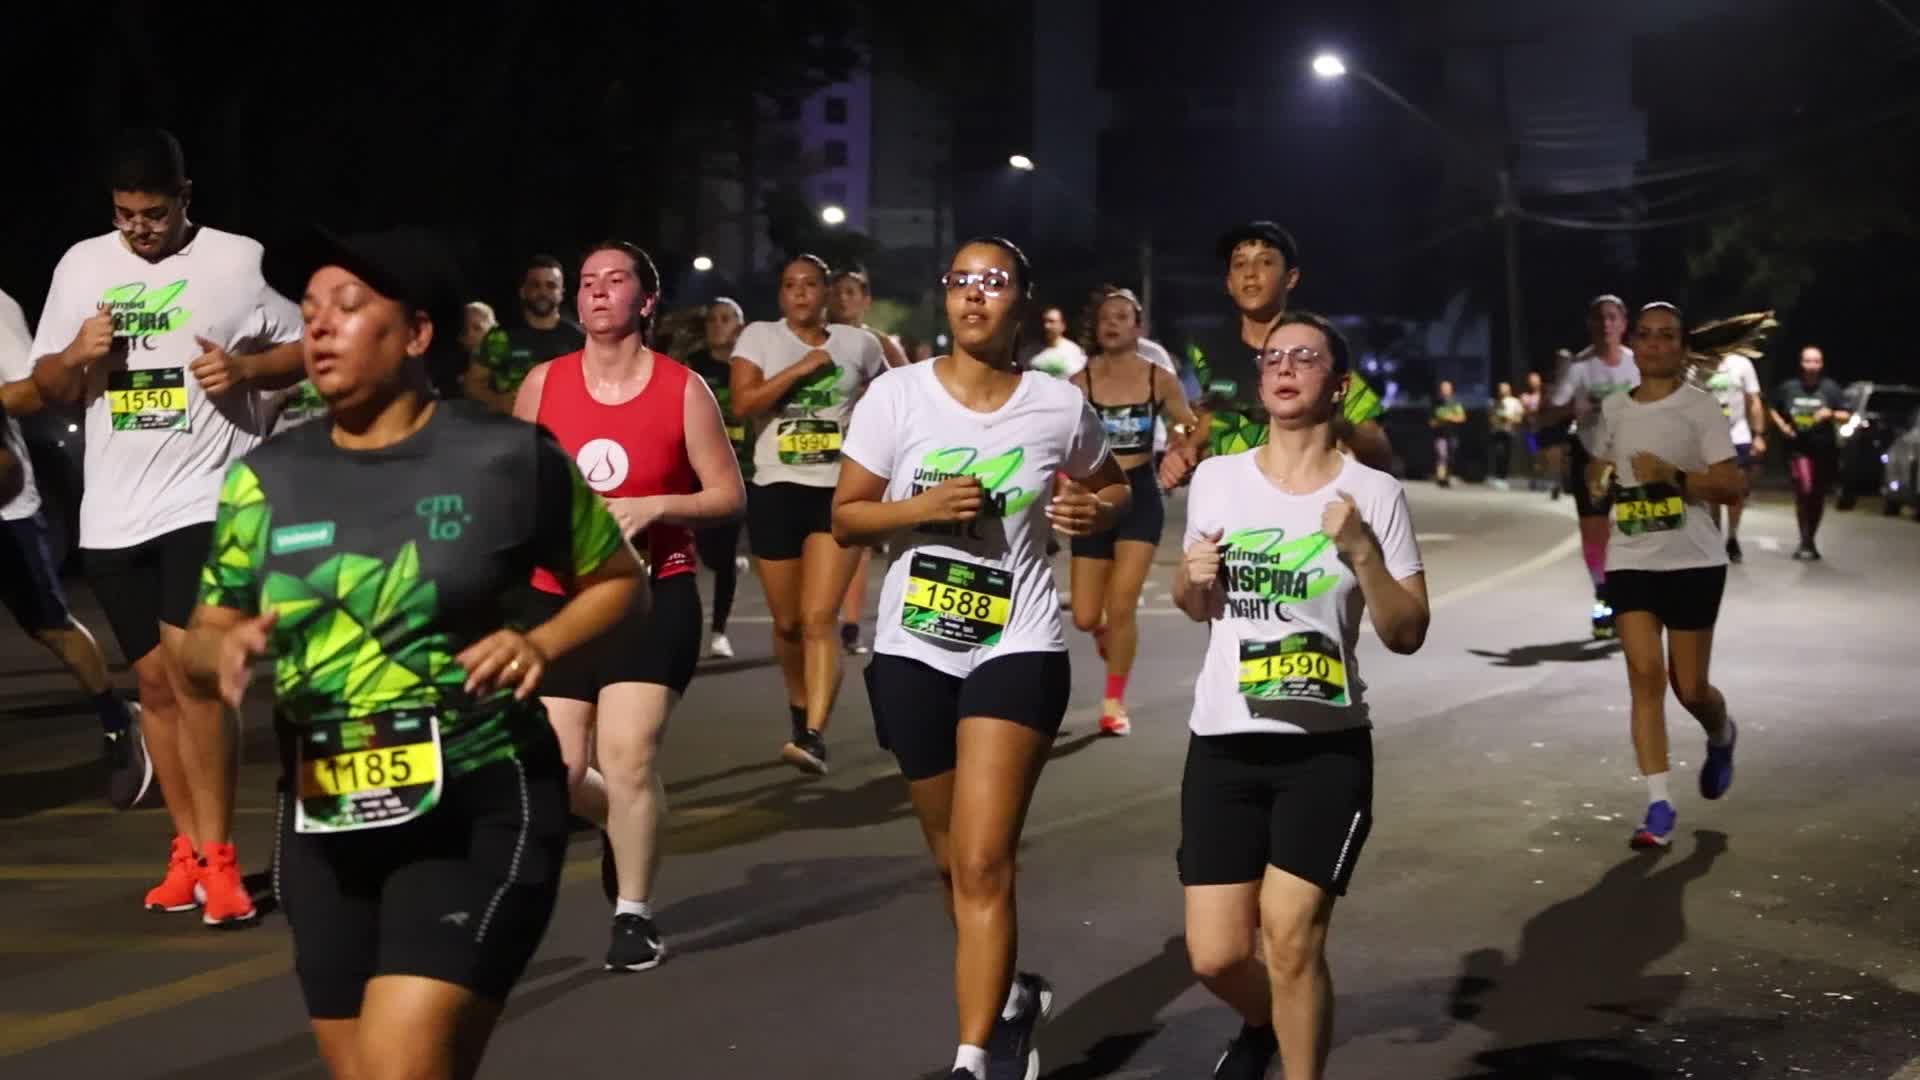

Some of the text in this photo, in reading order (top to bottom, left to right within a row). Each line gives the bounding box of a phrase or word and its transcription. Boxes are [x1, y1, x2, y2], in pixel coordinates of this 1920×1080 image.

[121, 390, 172, 412] 1550
[1226, 547, 1281, 565] nimed
[1222, 565, 1308, 600] NSPIRA
[927, 583, 992, 620] 1588
[1261, 654, 1330, 680] 1590
[325, 749, 412, 791] 1185
